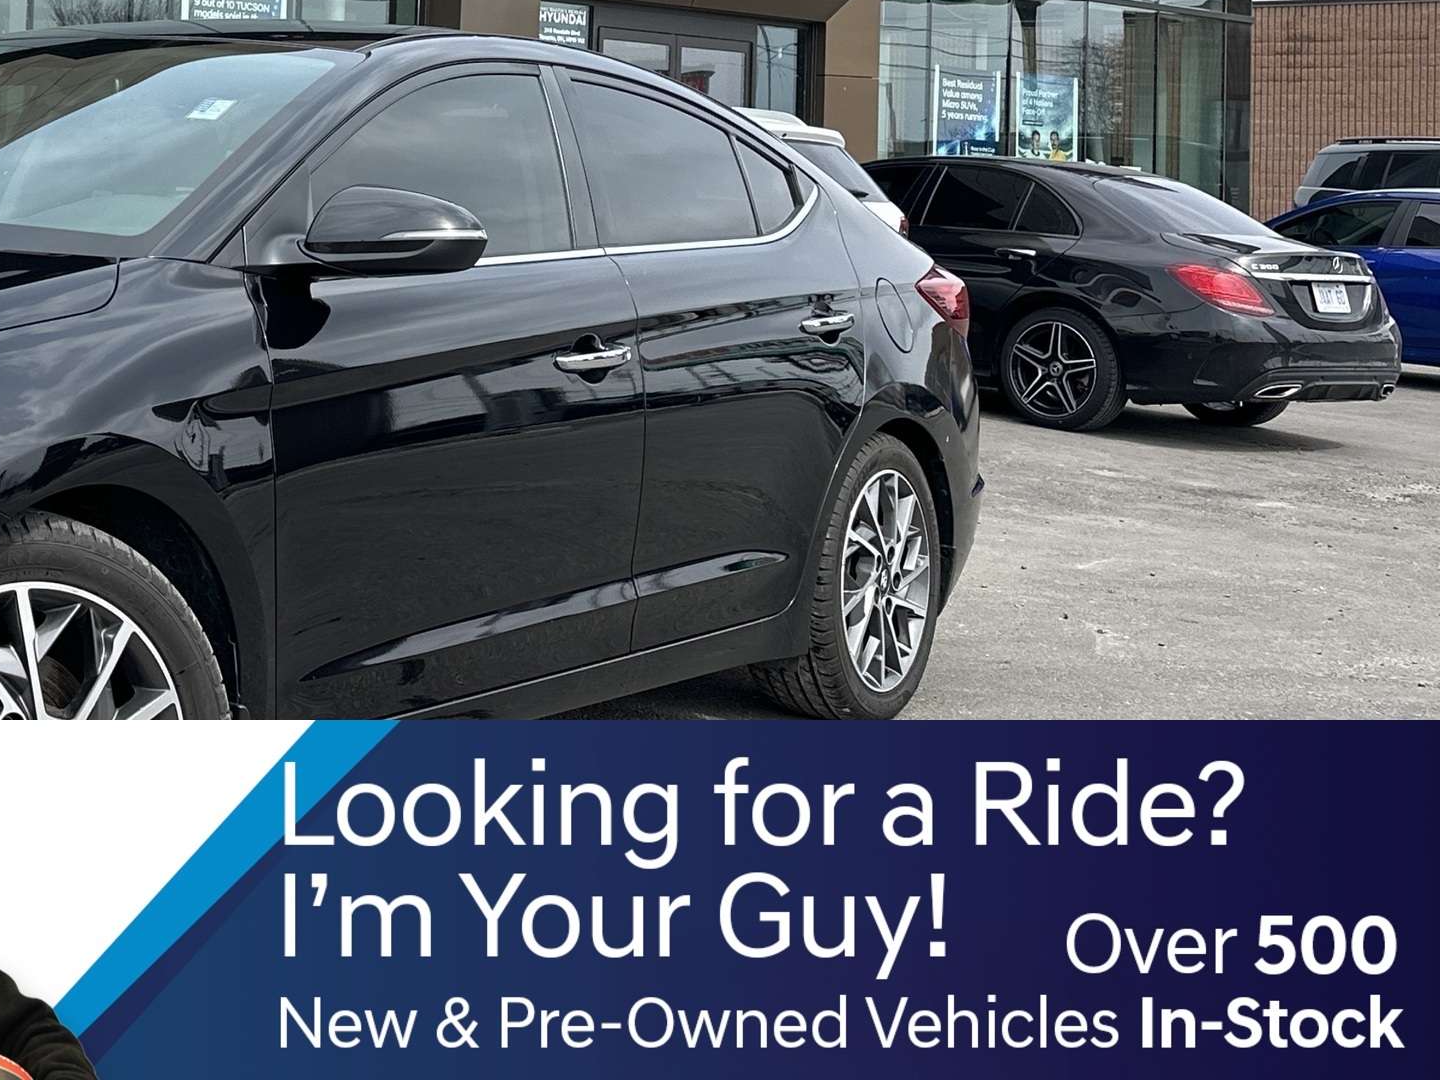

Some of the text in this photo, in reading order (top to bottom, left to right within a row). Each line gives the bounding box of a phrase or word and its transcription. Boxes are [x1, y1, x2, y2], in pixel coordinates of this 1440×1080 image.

[201, 0, 215, 7] out
[216, 0, 225, 8] of
[226, 0, 235, 10] 10
[236, 1, 271, 13] TUCSON
[539, 10, 587, 26] HYUNDAI
[941, 77, 984, 91] Best Residual
[941, 86, 983, 103] Value among
[941, 98, 960, 109] Micro
[941, 109, 947, 119] 5
[947, 111, 964, 120] years
